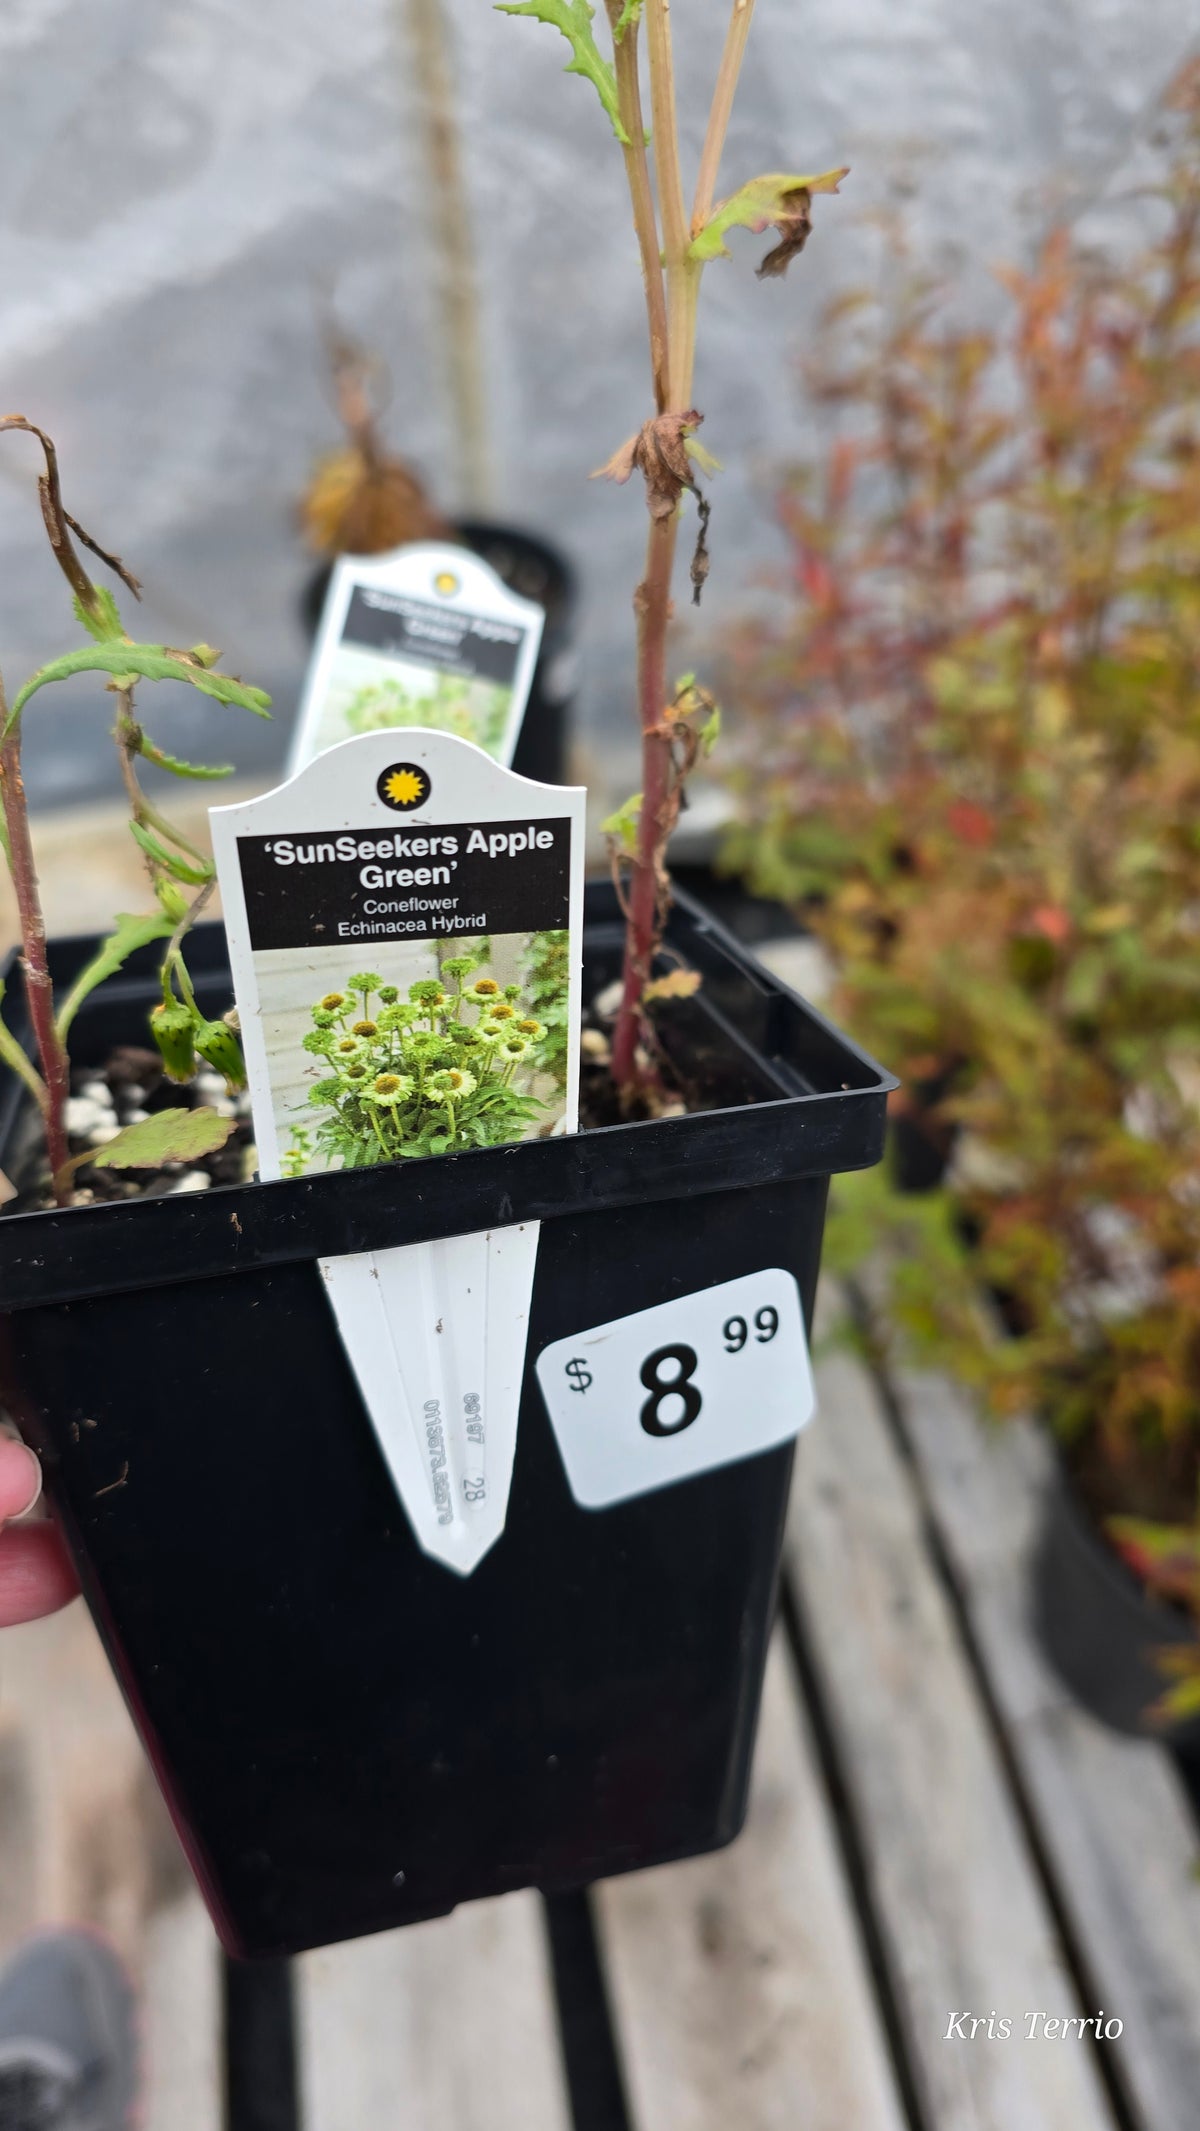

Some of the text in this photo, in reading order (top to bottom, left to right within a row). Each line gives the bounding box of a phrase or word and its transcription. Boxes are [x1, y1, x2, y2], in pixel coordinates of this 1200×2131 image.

[466, 826, 555, 857] Apple
[359, 861, 458, 890] Green’
[363, 897, 459, 915] Coneflower
[337, 913, 487, 937] Echinacea Hybrid
[565, 1305, 779, 1438] $ 8 99
[463, 1476, 486, 1502] 28
